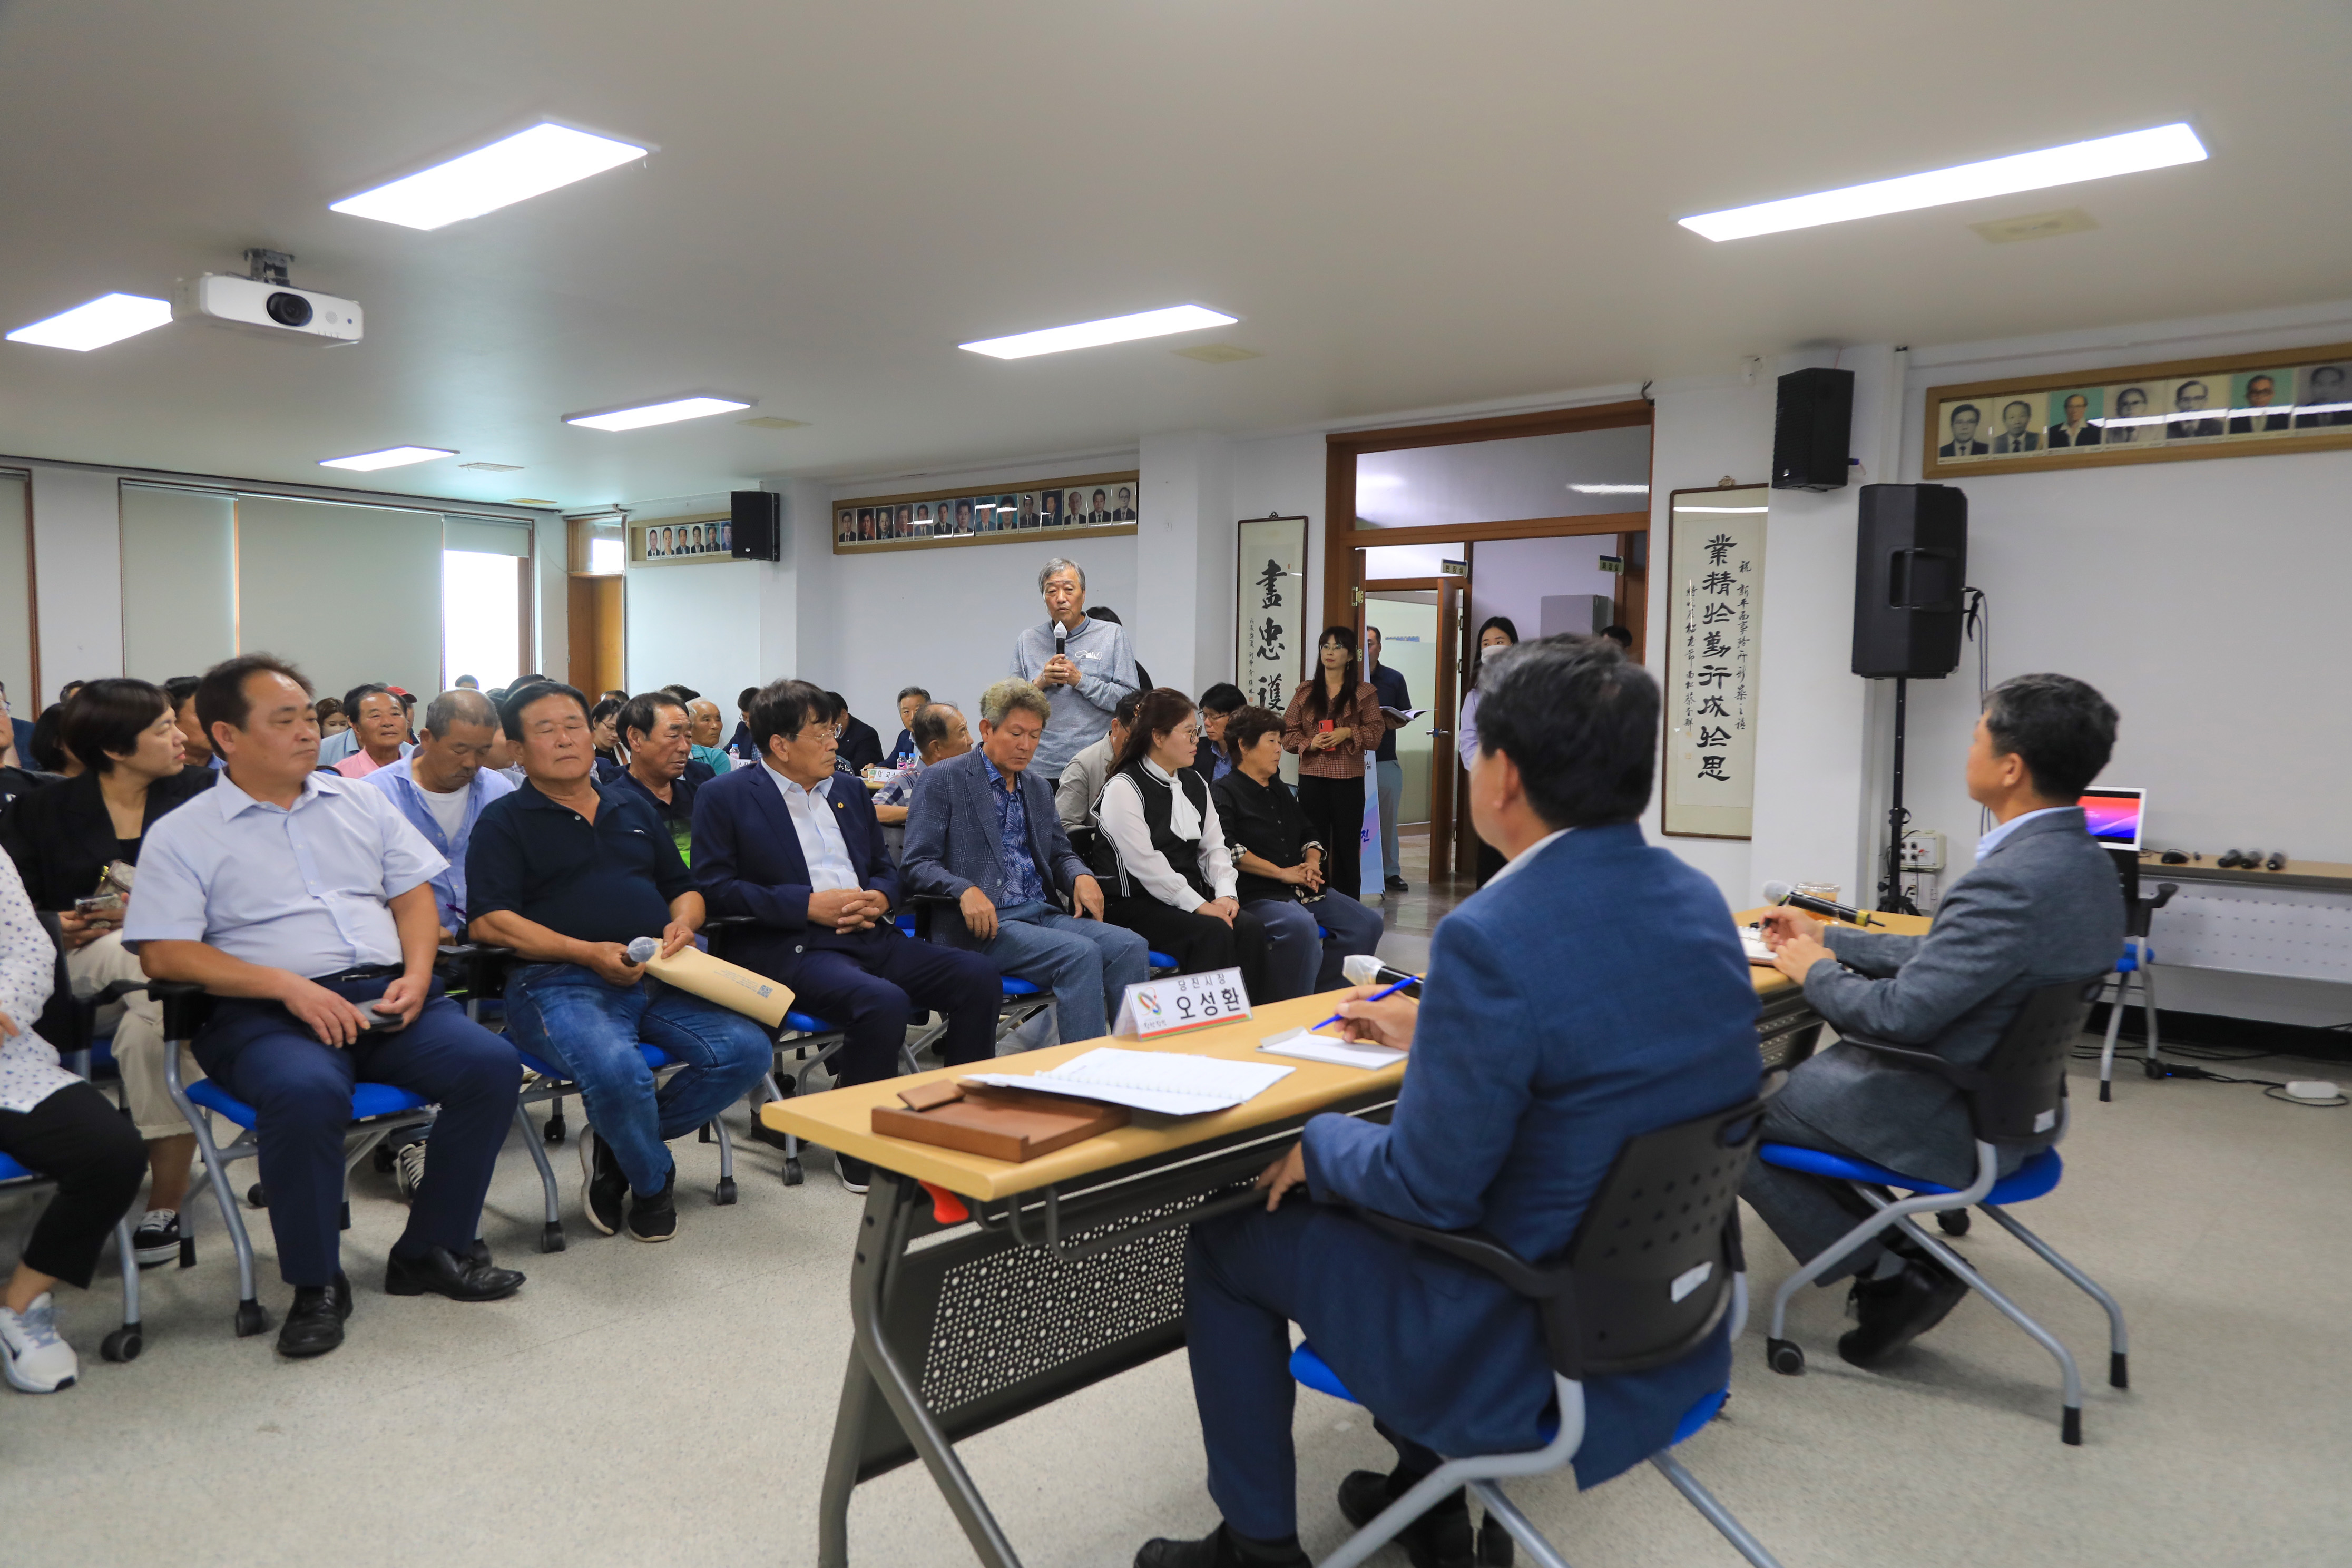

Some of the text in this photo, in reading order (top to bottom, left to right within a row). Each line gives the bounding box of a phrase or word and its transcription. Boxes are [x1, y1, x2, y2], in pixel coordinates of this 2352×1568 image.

[1445, 565, 1464, 574] 면장실
[1365, 761, 1371, 770] 실
[1360, 829, 1370, 843] 진
[1178, 972, 1226, 991] 당진시장
[1176, 986, 1241, 1020] 오성환
